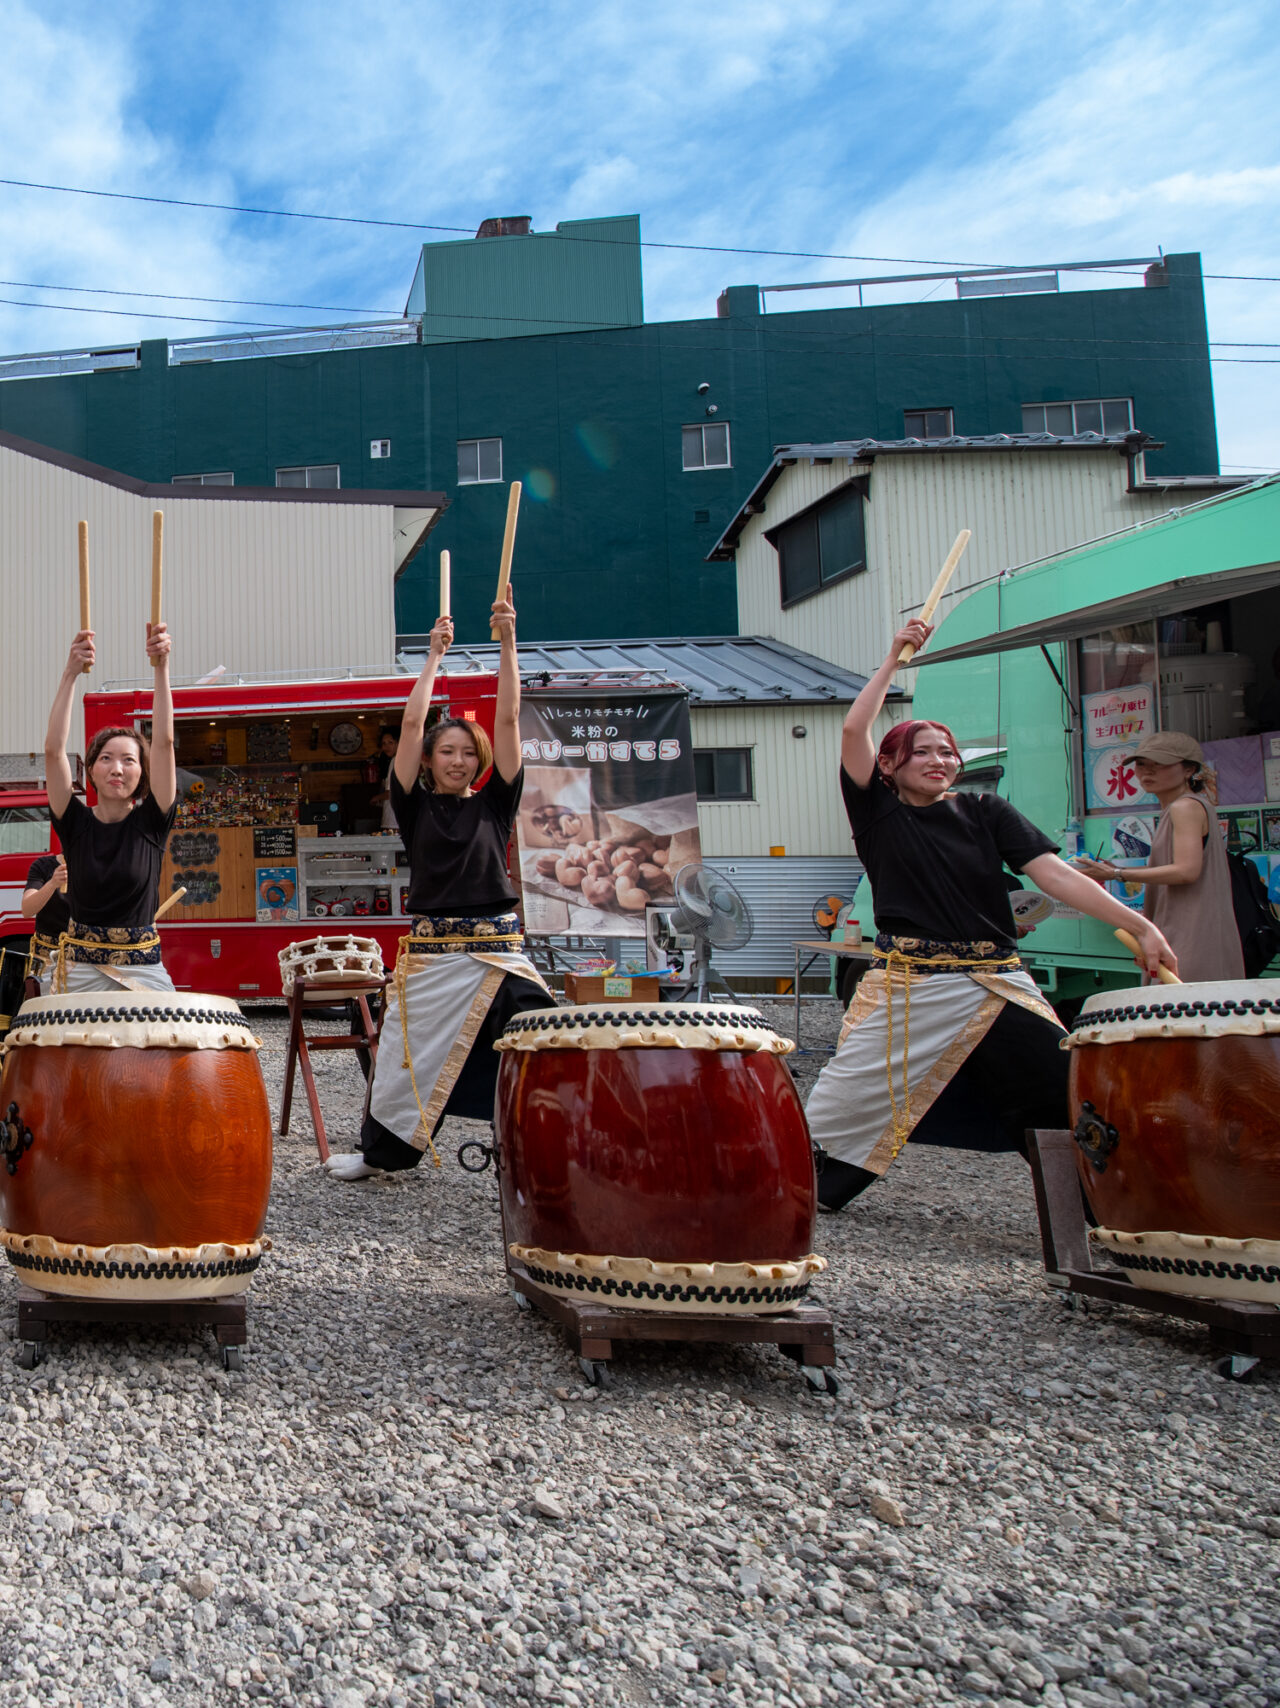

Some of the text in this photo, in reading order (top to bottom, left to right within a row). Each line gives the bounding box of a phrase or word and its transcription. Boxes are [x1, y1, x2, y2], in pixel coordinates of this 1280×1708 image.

[556, 708, 635, 718] しっとりモチモチ
[1089, 699, 1147, 719] フルーツ乗せ
[571, 725, 619, 739] 米粉の
[1095, 720, 1145, 738] 生シロップ
[1106, 765, 1138, 801] 氷
